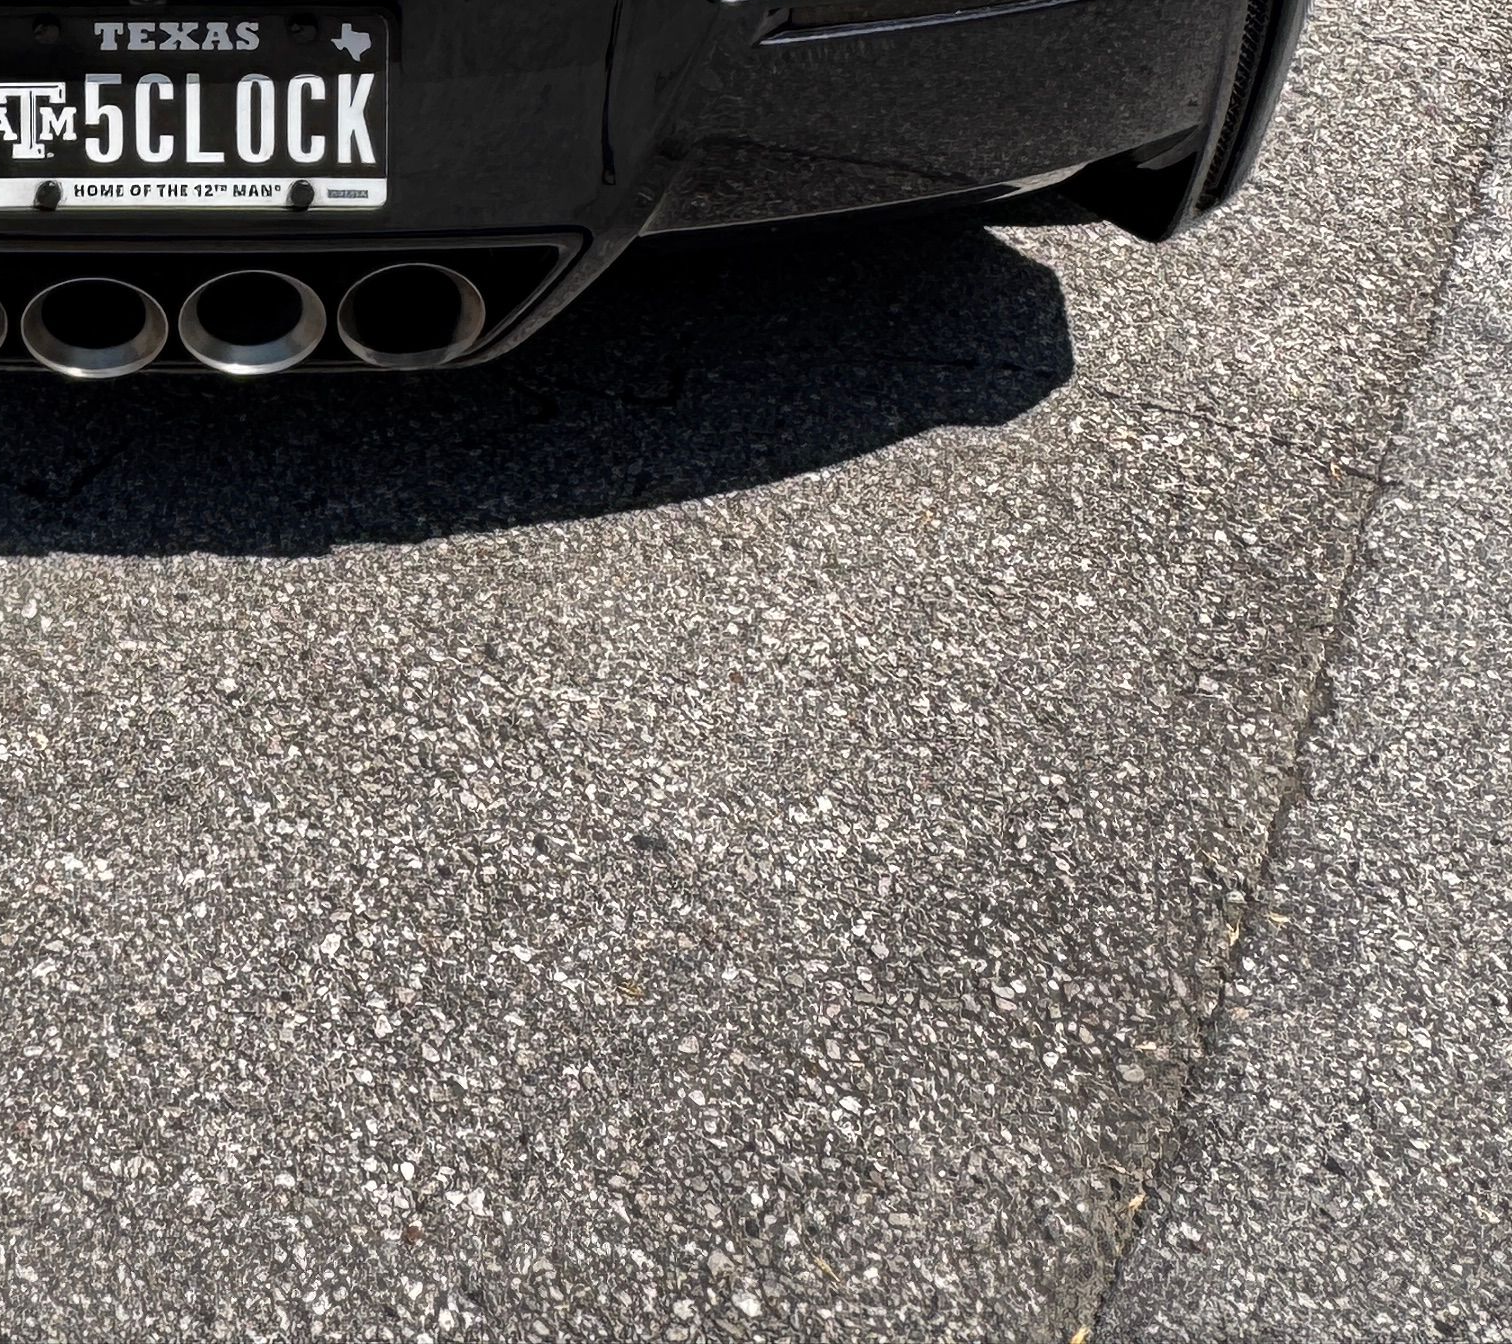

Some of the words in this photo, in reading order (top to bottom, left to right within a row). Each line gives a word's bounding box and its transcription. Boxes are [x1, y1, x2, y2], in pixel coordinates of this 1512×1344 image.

[94, 22, 260, 51] TEXAS
[85, 73, 376, 164] 5CLOCK
[73, 184, 124, 197] HOME
[129, 184, 152, 197] OF
[156, 184, 188, 197] THE
